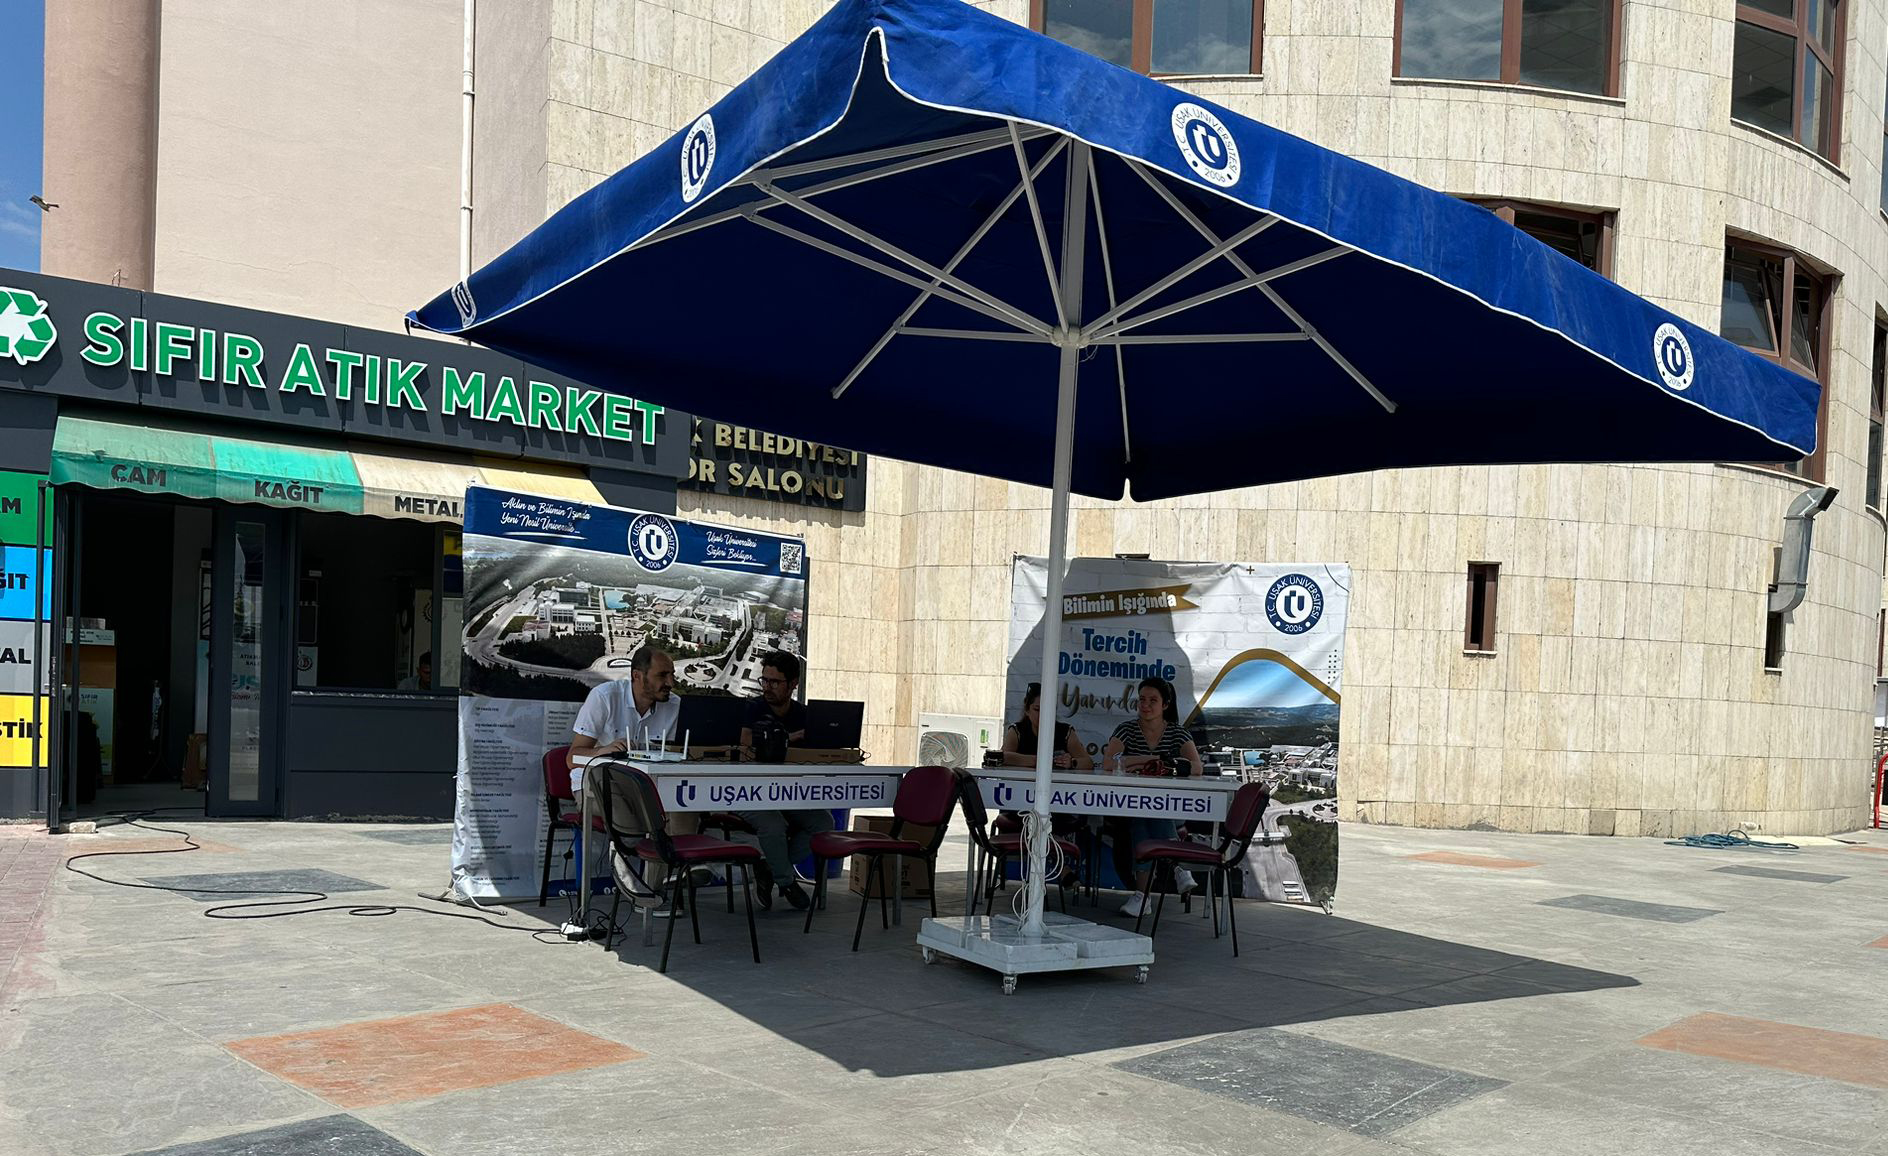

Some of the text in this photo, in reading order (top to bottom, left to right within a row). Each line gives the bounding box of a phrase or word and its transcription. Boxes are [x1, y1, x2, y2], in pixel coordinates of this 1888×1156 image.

[80, 312, 665, 446] SIFIR ATIK MARKET
[111, 463, 167, 487] CAM
[728, 462, 846, 500] SALONU
[254, 479, 324, 504] KAĞIT
[645, 560, 662, 569] 2006
[1063, 591, 1177, 615] Bilimin Işığında
[1284, 624, 1303, 632] 2006
[1082, 628, 1147, 655] Tercih
[1058, 652, 1176, 681] Döneminde
[710, 781, 885, 806] UŞAK ÜNİVERSİTESİ
[1026, 789, 1211, 813] UAK ÜNİVERSİTESİ
